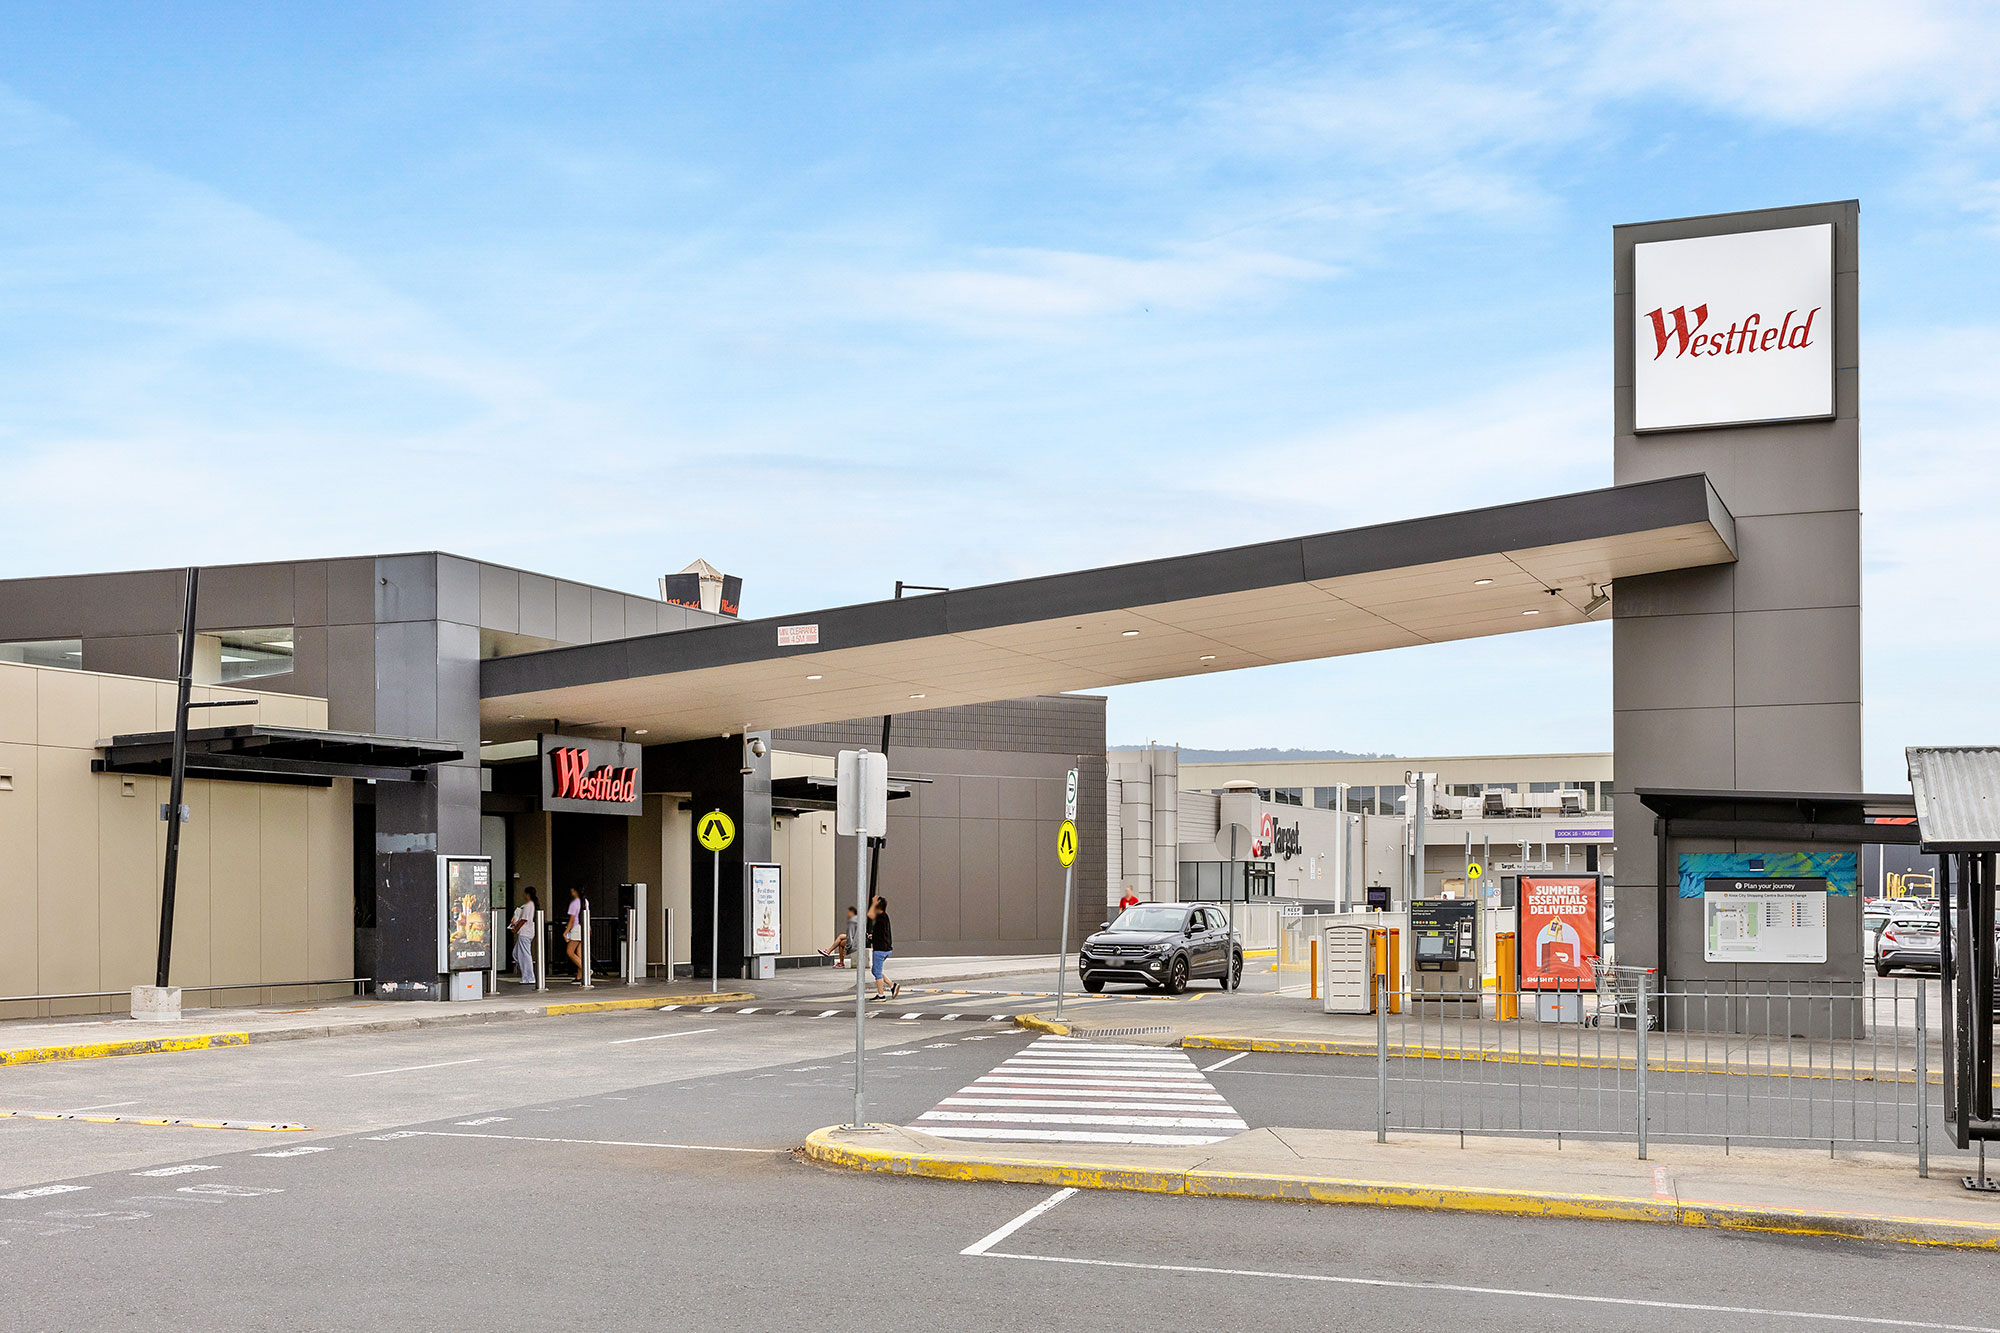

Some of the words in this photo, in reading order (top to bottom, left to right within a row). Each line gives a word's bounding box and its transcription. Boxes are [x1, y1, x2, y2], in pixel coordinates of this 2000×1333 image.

[1644, 303, 1821, 361] Westfield
[790, 626, 817, 635] CLEARANCE
[547, 747, 638, 803] Westfield
[1536, 886, 1580, 895] SUMMER
[1529, 896, 1588, 905] ESSENTIALS
[1530, 905, 1586, 915] DELIVERED
